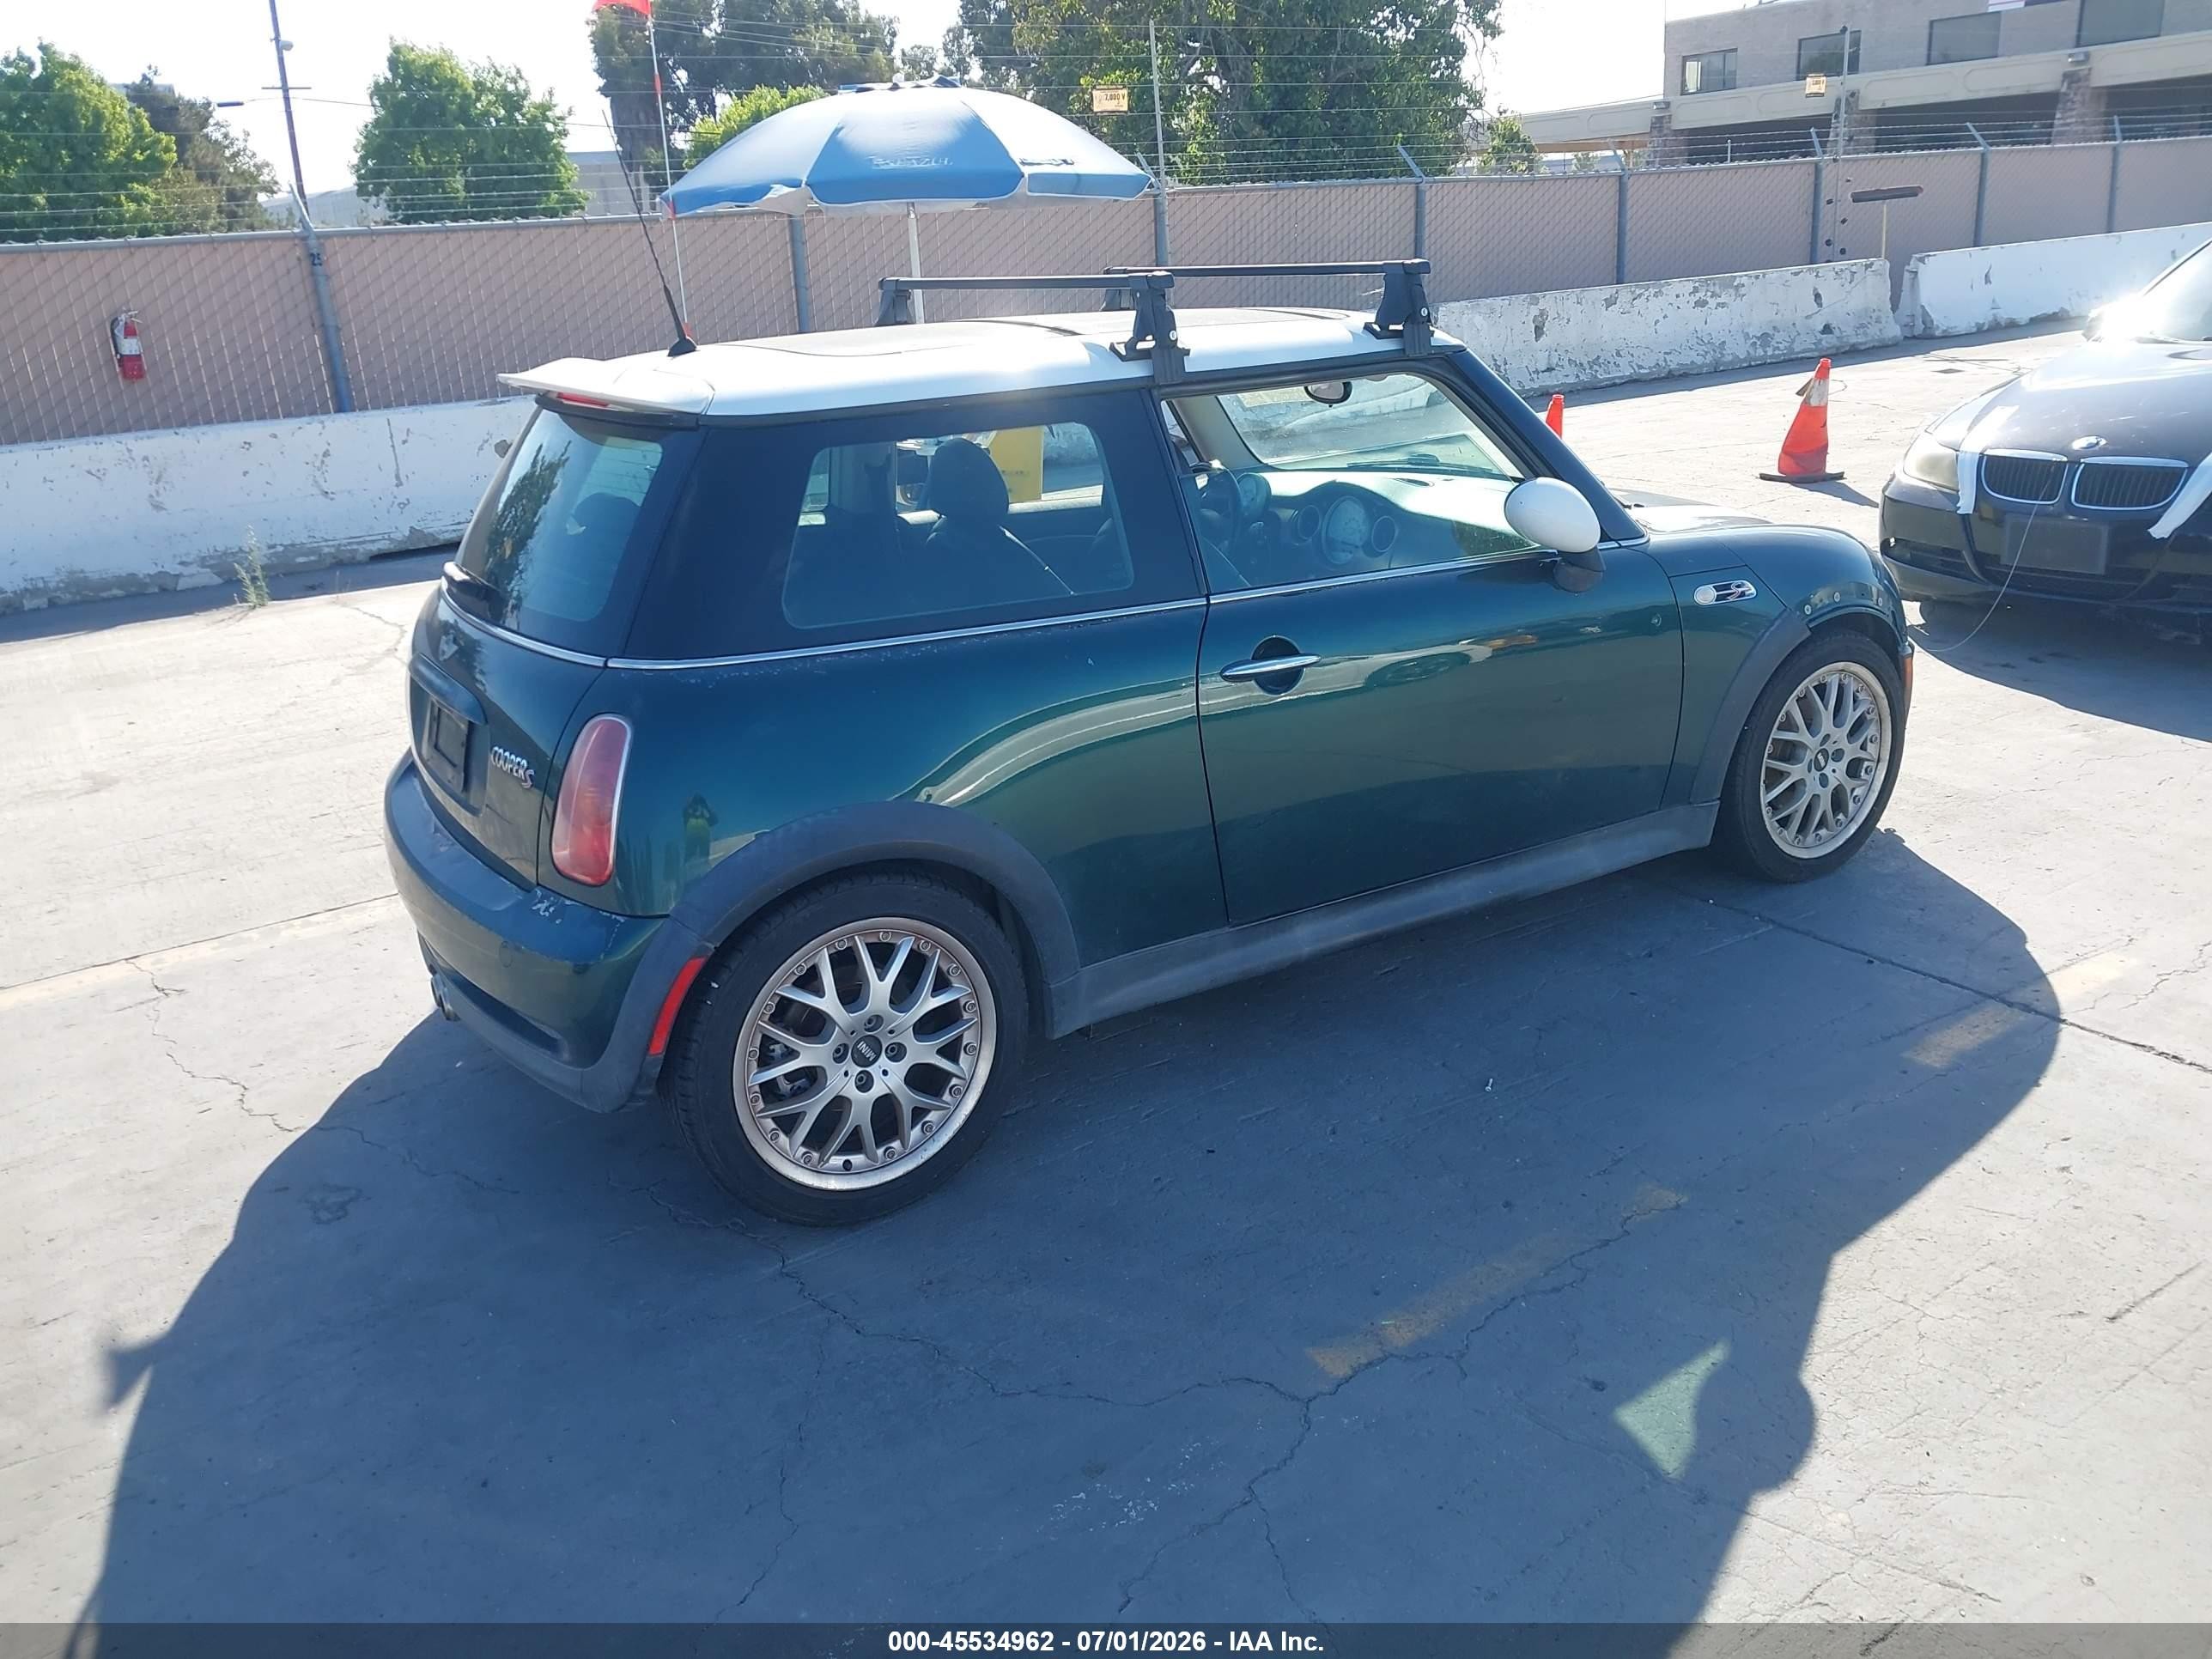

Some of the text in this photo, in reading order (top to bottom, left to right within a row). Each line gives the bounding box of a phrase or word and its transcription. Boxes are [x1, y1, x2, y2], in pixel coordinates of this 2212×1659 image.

[1104, 92, 1126, 101] 7,000 V
[857, 1040, 877, 1061] MINI
